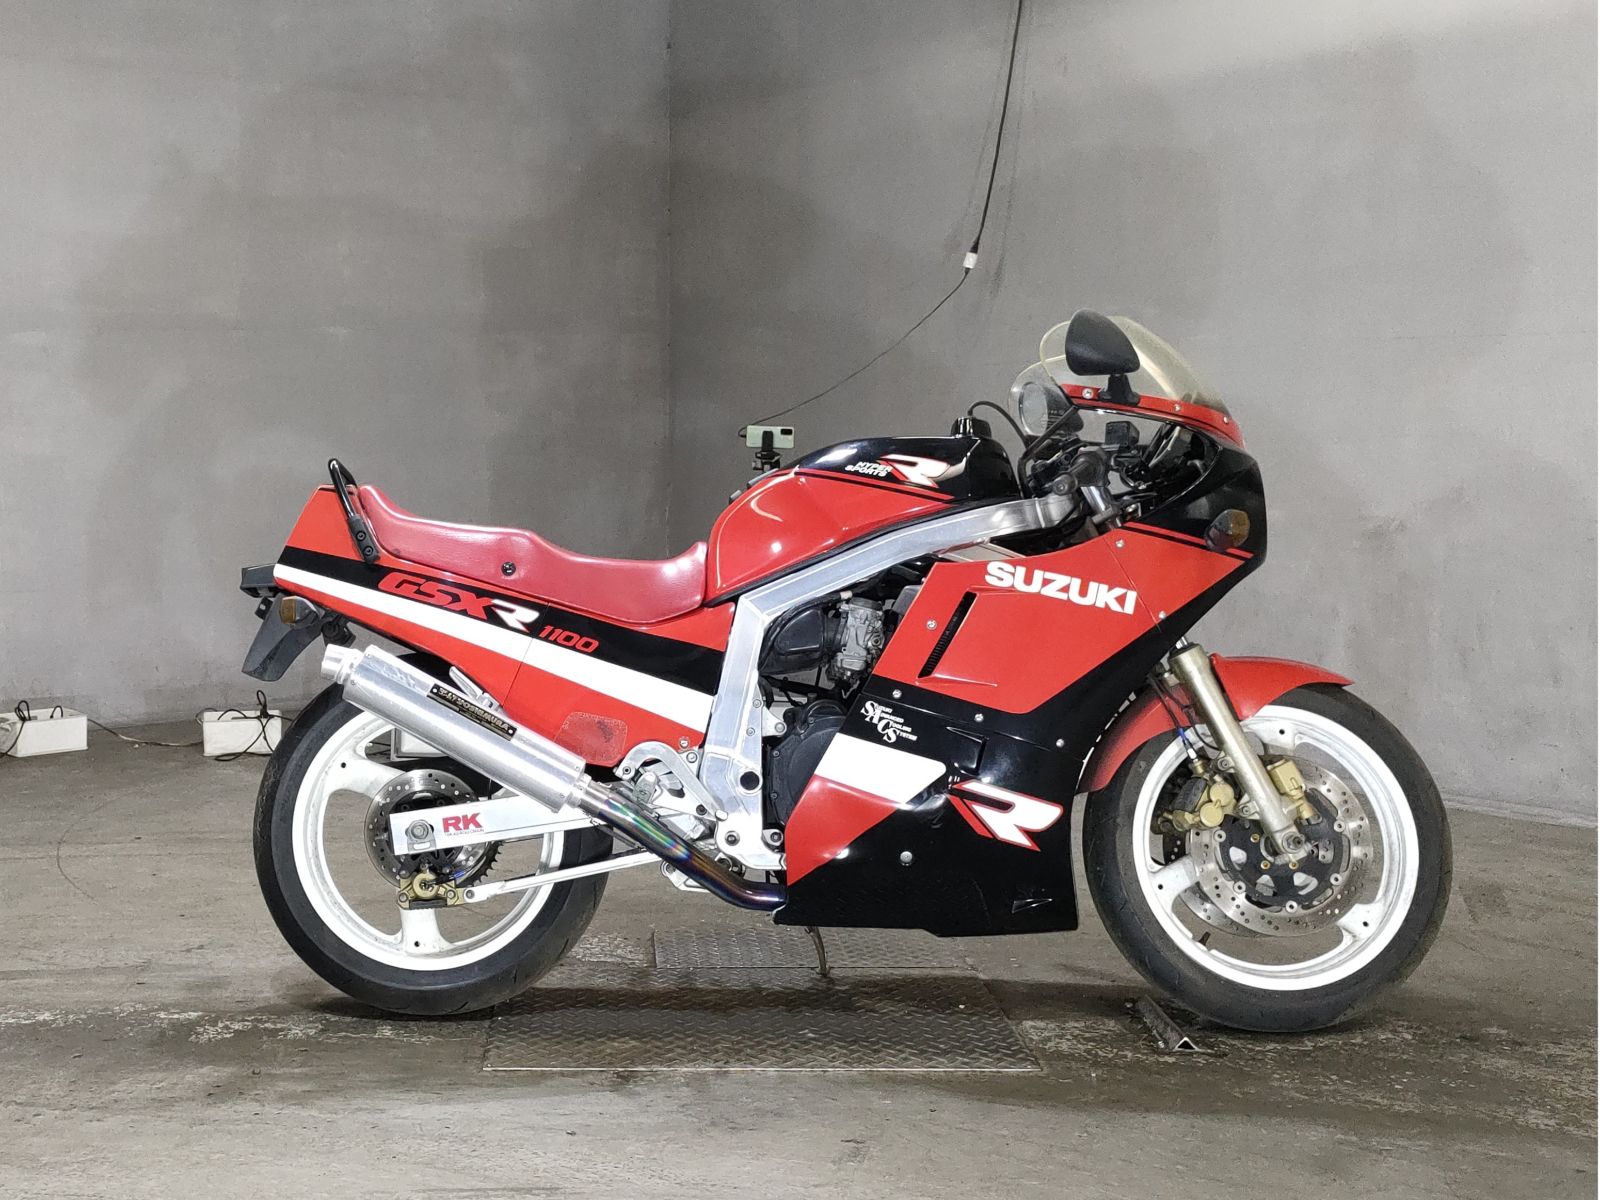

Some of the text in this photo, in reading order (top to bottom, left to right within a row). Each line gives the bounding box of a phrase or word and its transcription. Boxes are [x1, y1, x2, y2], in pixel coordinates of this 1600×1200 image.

[844, 464, 888, 477] SPORTS
[984, 561, 1138, 616] SUZUKI
[538, 625, 599, 653] 1100
[442, 812, 483, 833] RK
[950, 779, 1064, 852] R
